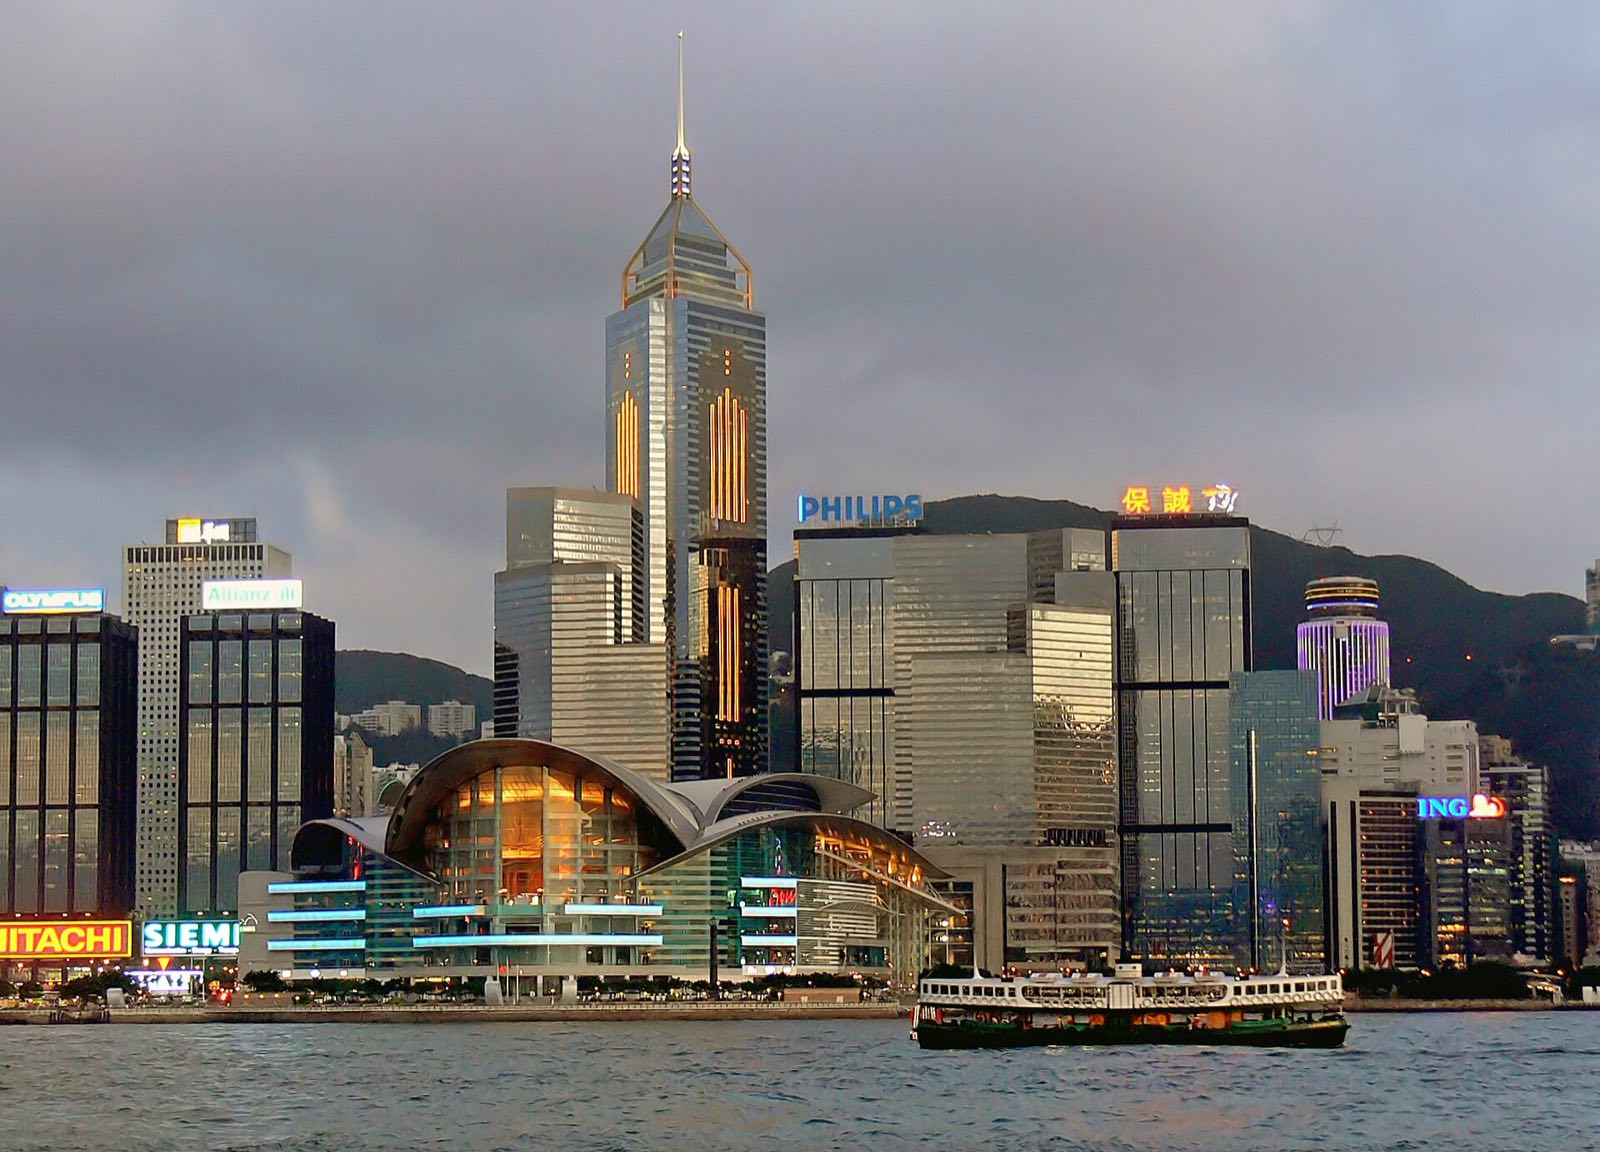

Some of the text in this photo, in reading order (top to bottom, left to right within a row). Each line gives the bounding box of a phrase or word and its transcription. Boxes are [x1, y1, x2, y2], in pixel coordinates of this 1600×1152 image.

[798, 494, 923, 525] PHILIPS
[1122, 486, 1191, 513] 保誠
[5, 591, 102, 608] OLYMPUS
[208, 585, 271, 602] Allianz
[1417, 797, 1468, 817] ING
